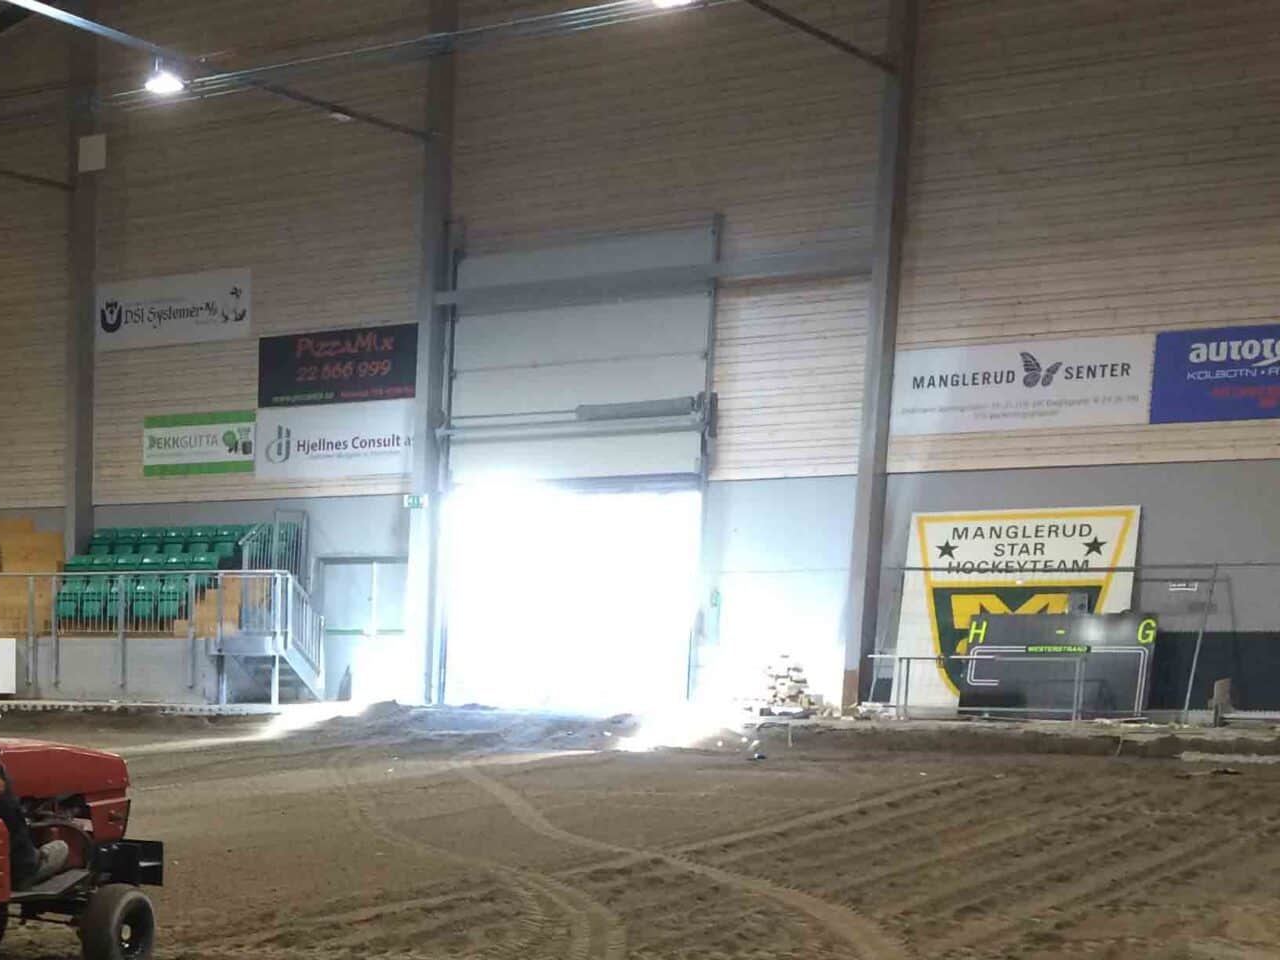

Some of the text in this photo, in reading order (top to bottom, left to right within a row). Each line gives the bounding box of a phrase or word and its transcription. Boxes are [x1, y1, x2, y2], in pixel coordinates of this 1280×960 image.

[912, 362, 1132, 390] MANGLERUD SENTER
[1186, 368, 1258, 380] KOLBOTN
[296, 438, 349, 455] Hjellnes
[351, 434, 401, 449] Consult
[952, 523, 1093, 541] MANGLERUD
[993, 542, 1046, 557] STAR
[947, 559, 1091, 575] HOCKEYTEAM
[968, 619, 989, 645] H
[1136, 618, 1157, 645] G
